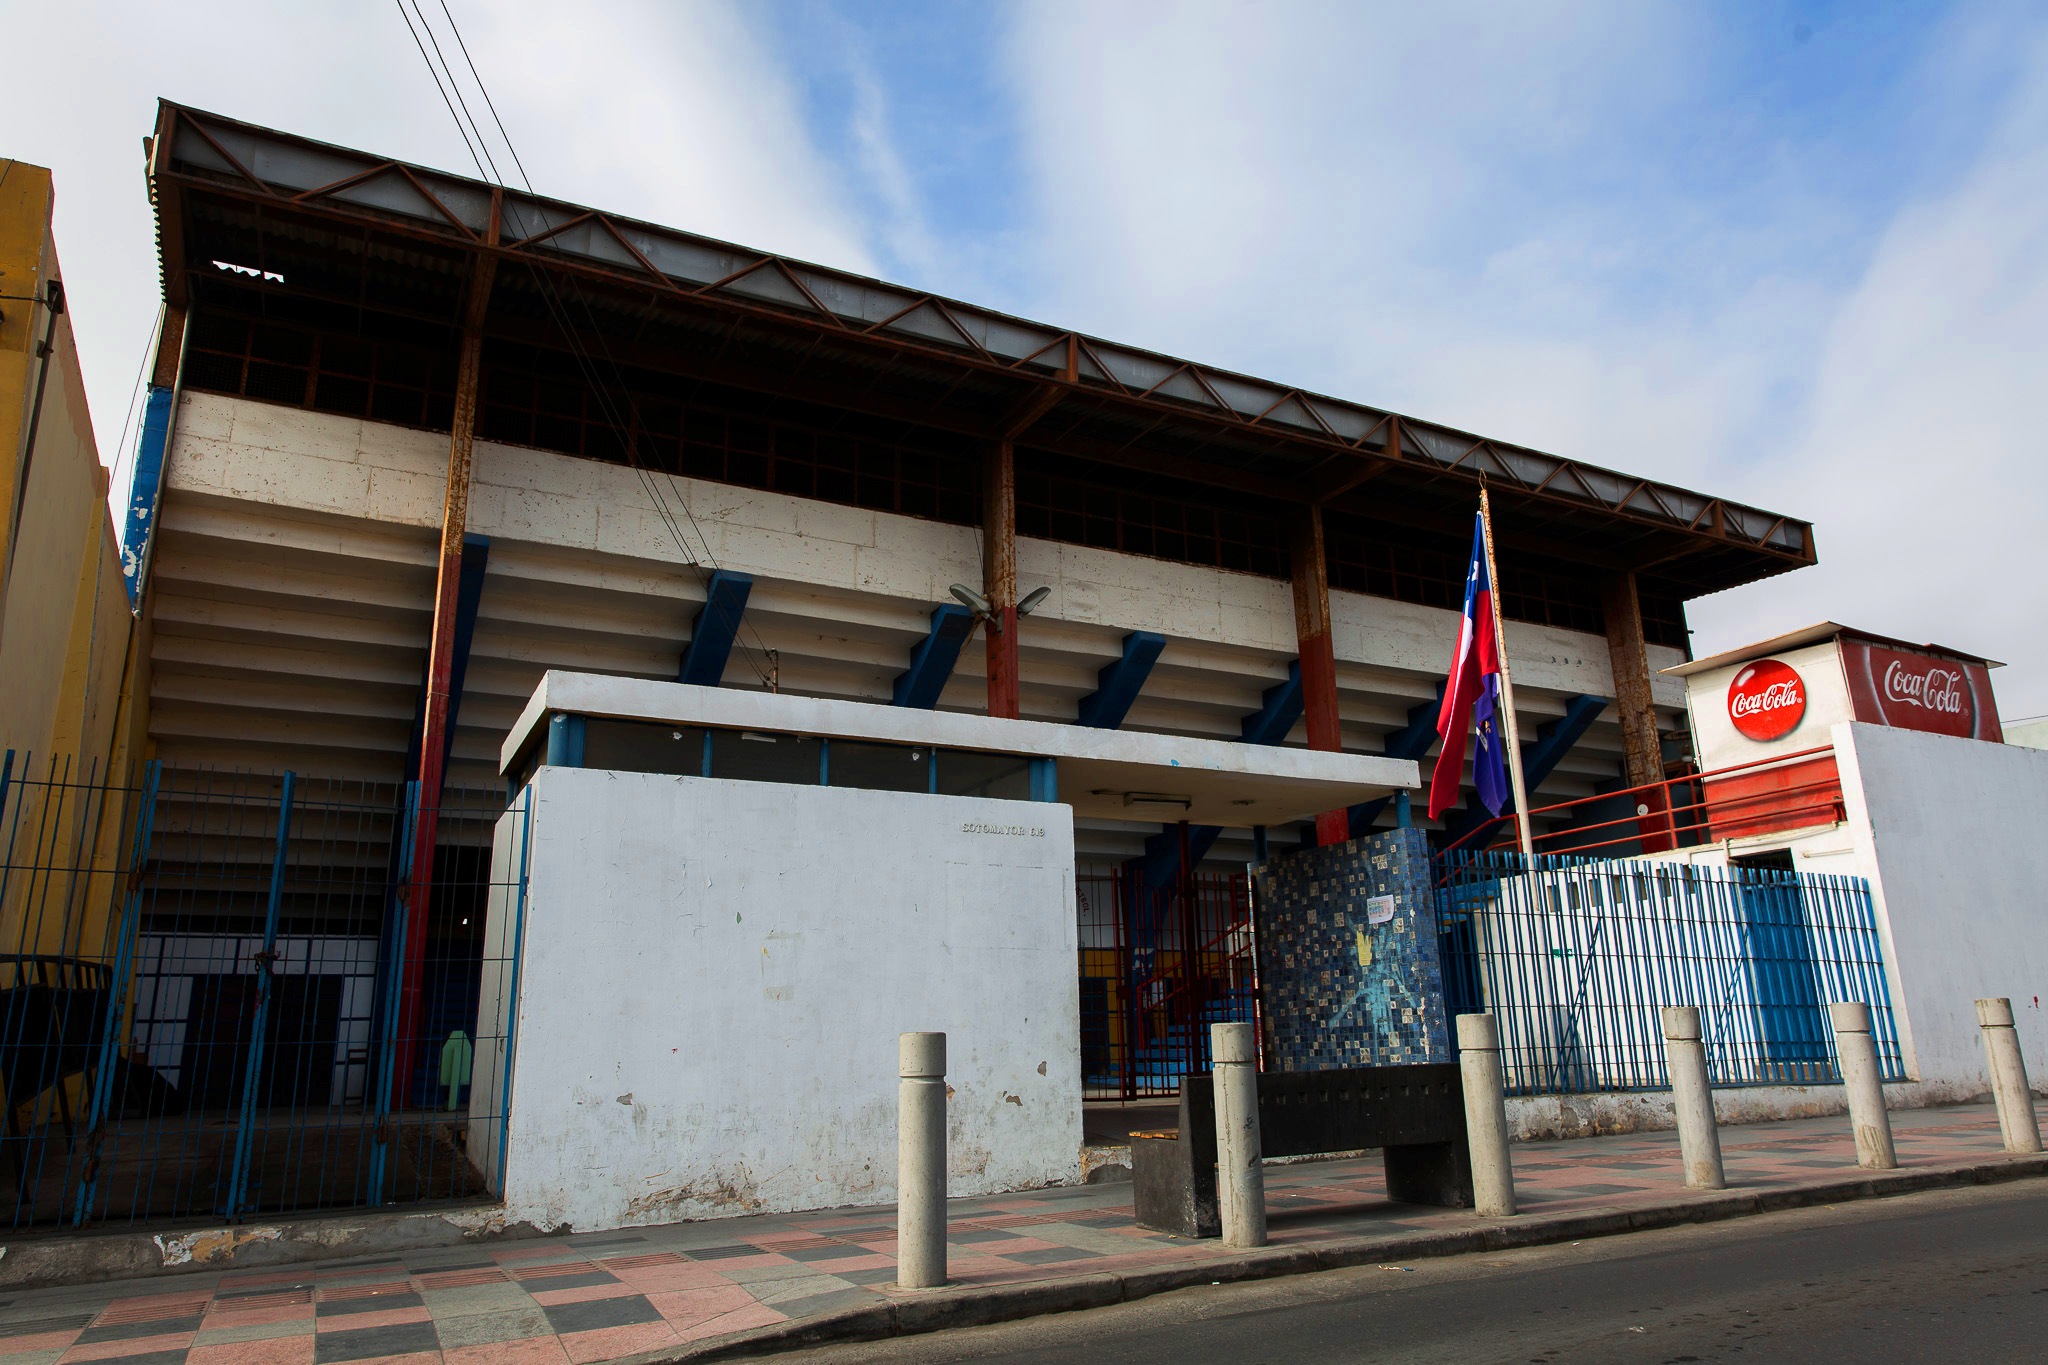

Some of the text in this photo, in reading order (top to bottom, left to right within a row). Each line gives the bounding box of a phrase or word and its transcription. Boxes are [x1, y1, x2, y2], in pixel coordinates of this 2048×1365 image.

[1731, 678, 1798, 718] Coca-Cola
[1884, 660, 1961, 713] Coca-Cola
[962, 823, 1045, 837] SOTOMAYOR 619
